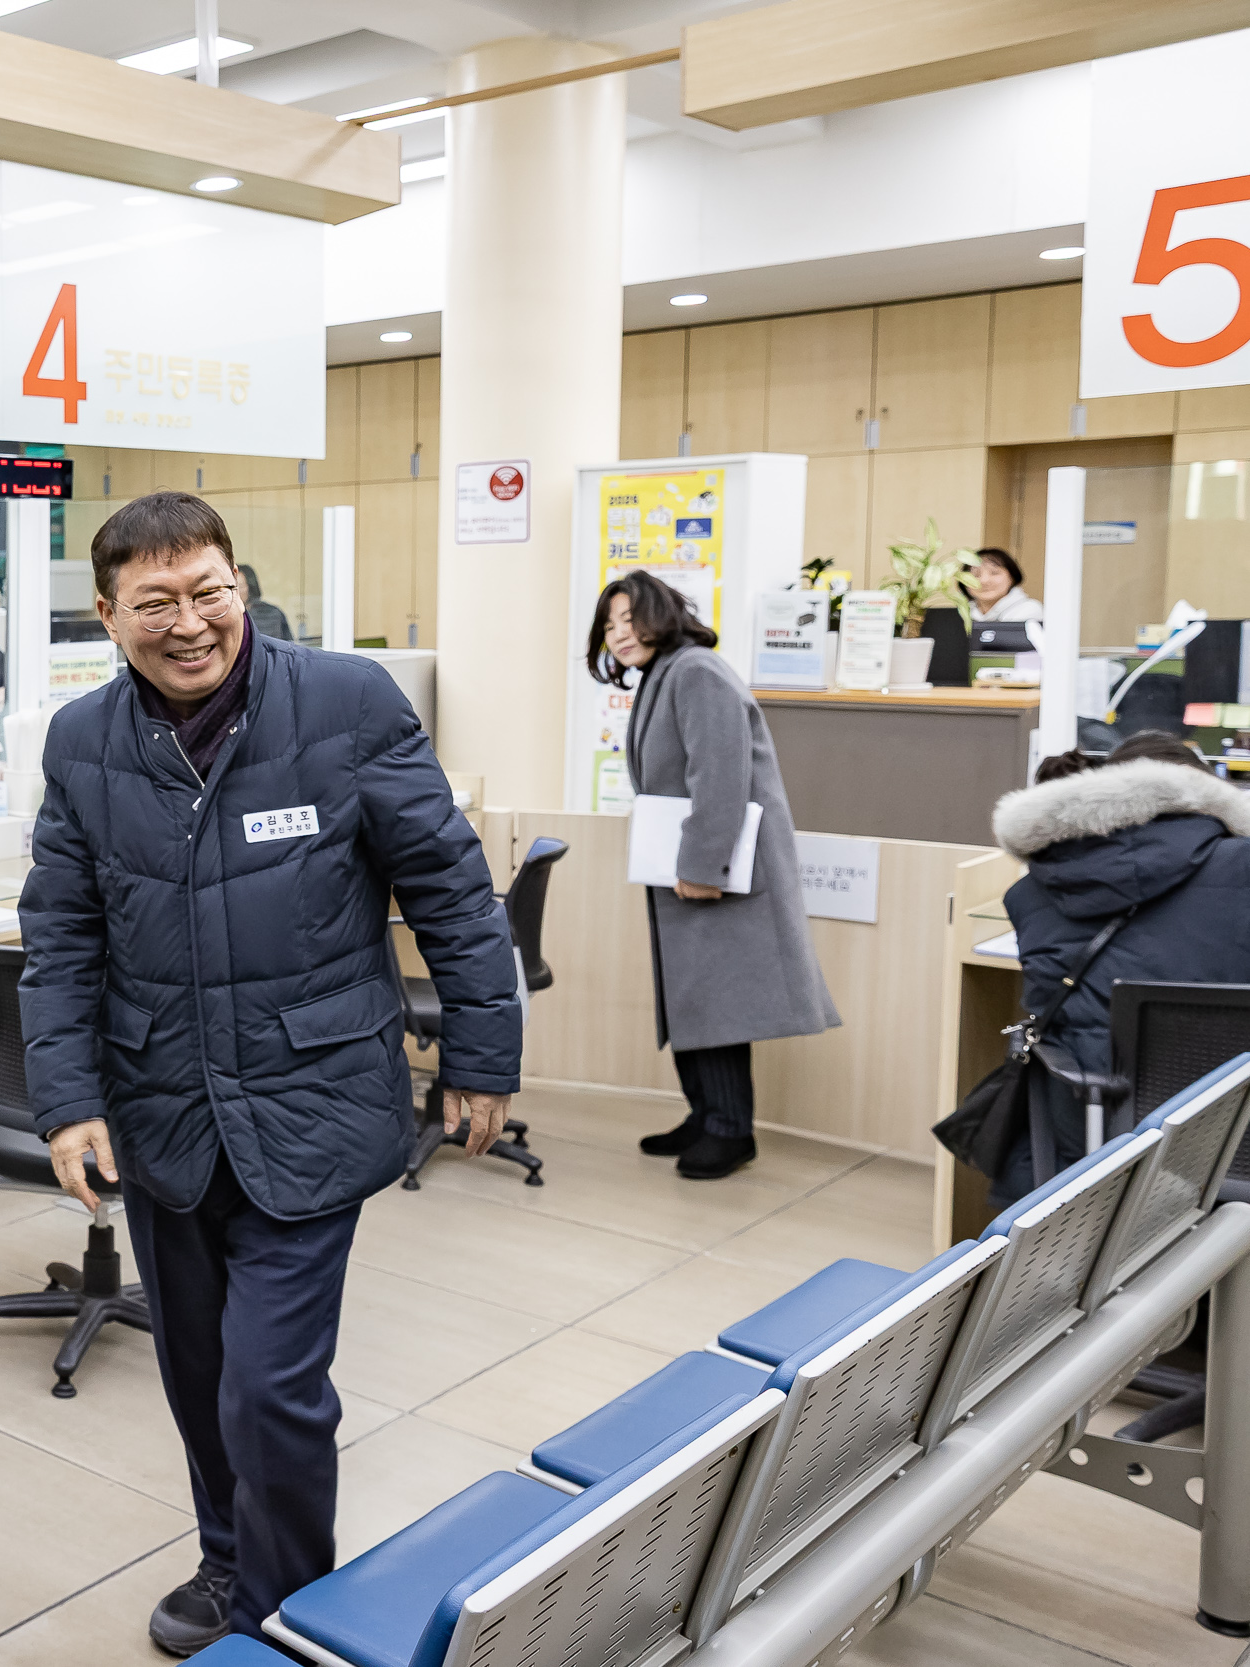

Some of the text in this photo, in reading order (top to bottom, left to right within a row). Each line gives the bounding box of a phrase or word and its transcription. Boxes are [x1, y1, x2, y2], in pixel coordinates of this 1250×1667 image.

[1122, 174, 1250, 368] 5
[22, 283, 87, 424] 4
[105, 349, 251, 405] 주민등록증
[608, 542, 639, 560] 카드
